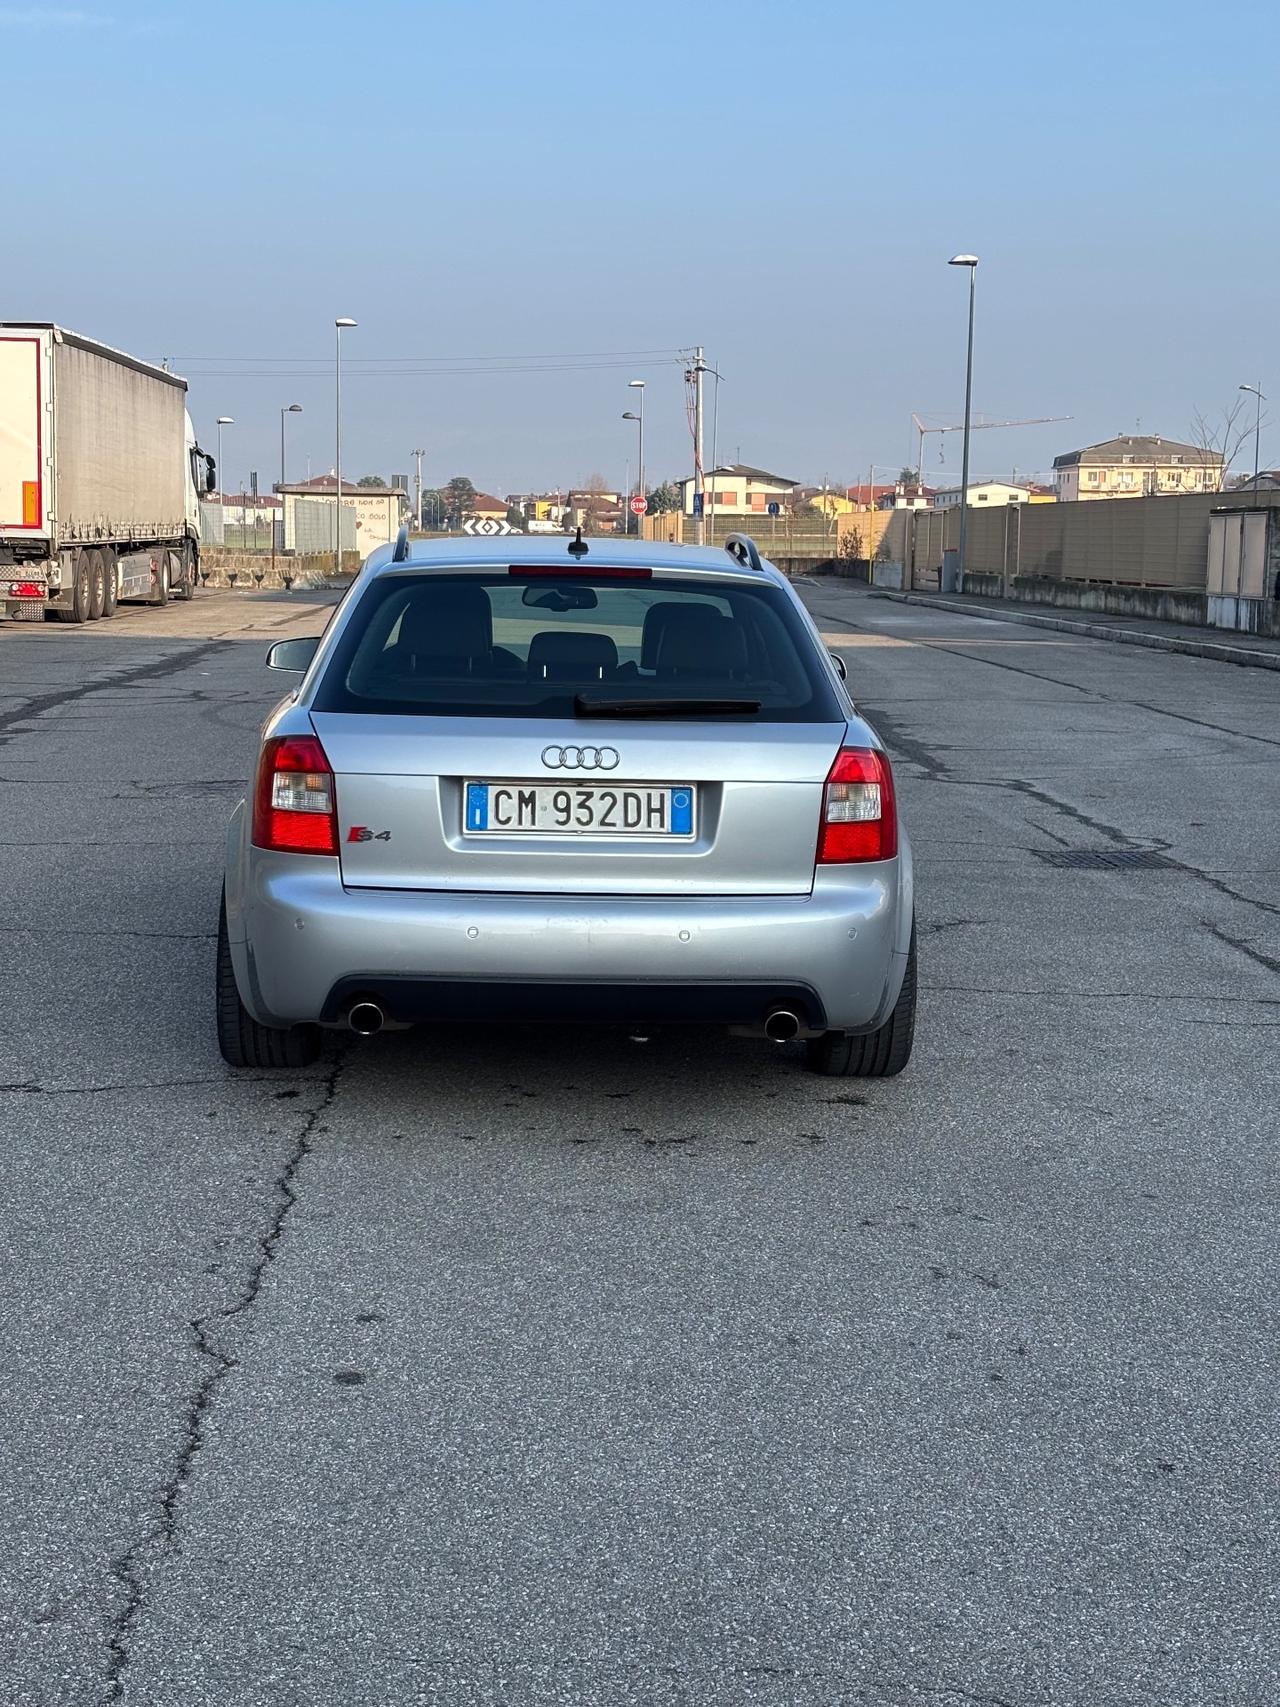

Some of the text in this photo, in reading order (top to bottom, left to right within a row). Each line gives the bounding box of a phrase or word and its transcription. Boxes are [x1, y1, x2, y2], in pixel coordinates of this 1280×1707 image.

[631, 501, 646, 509] STOP
[494, 790, 666, 829] CM 932DH
[352, 828, 392, 842] S4
